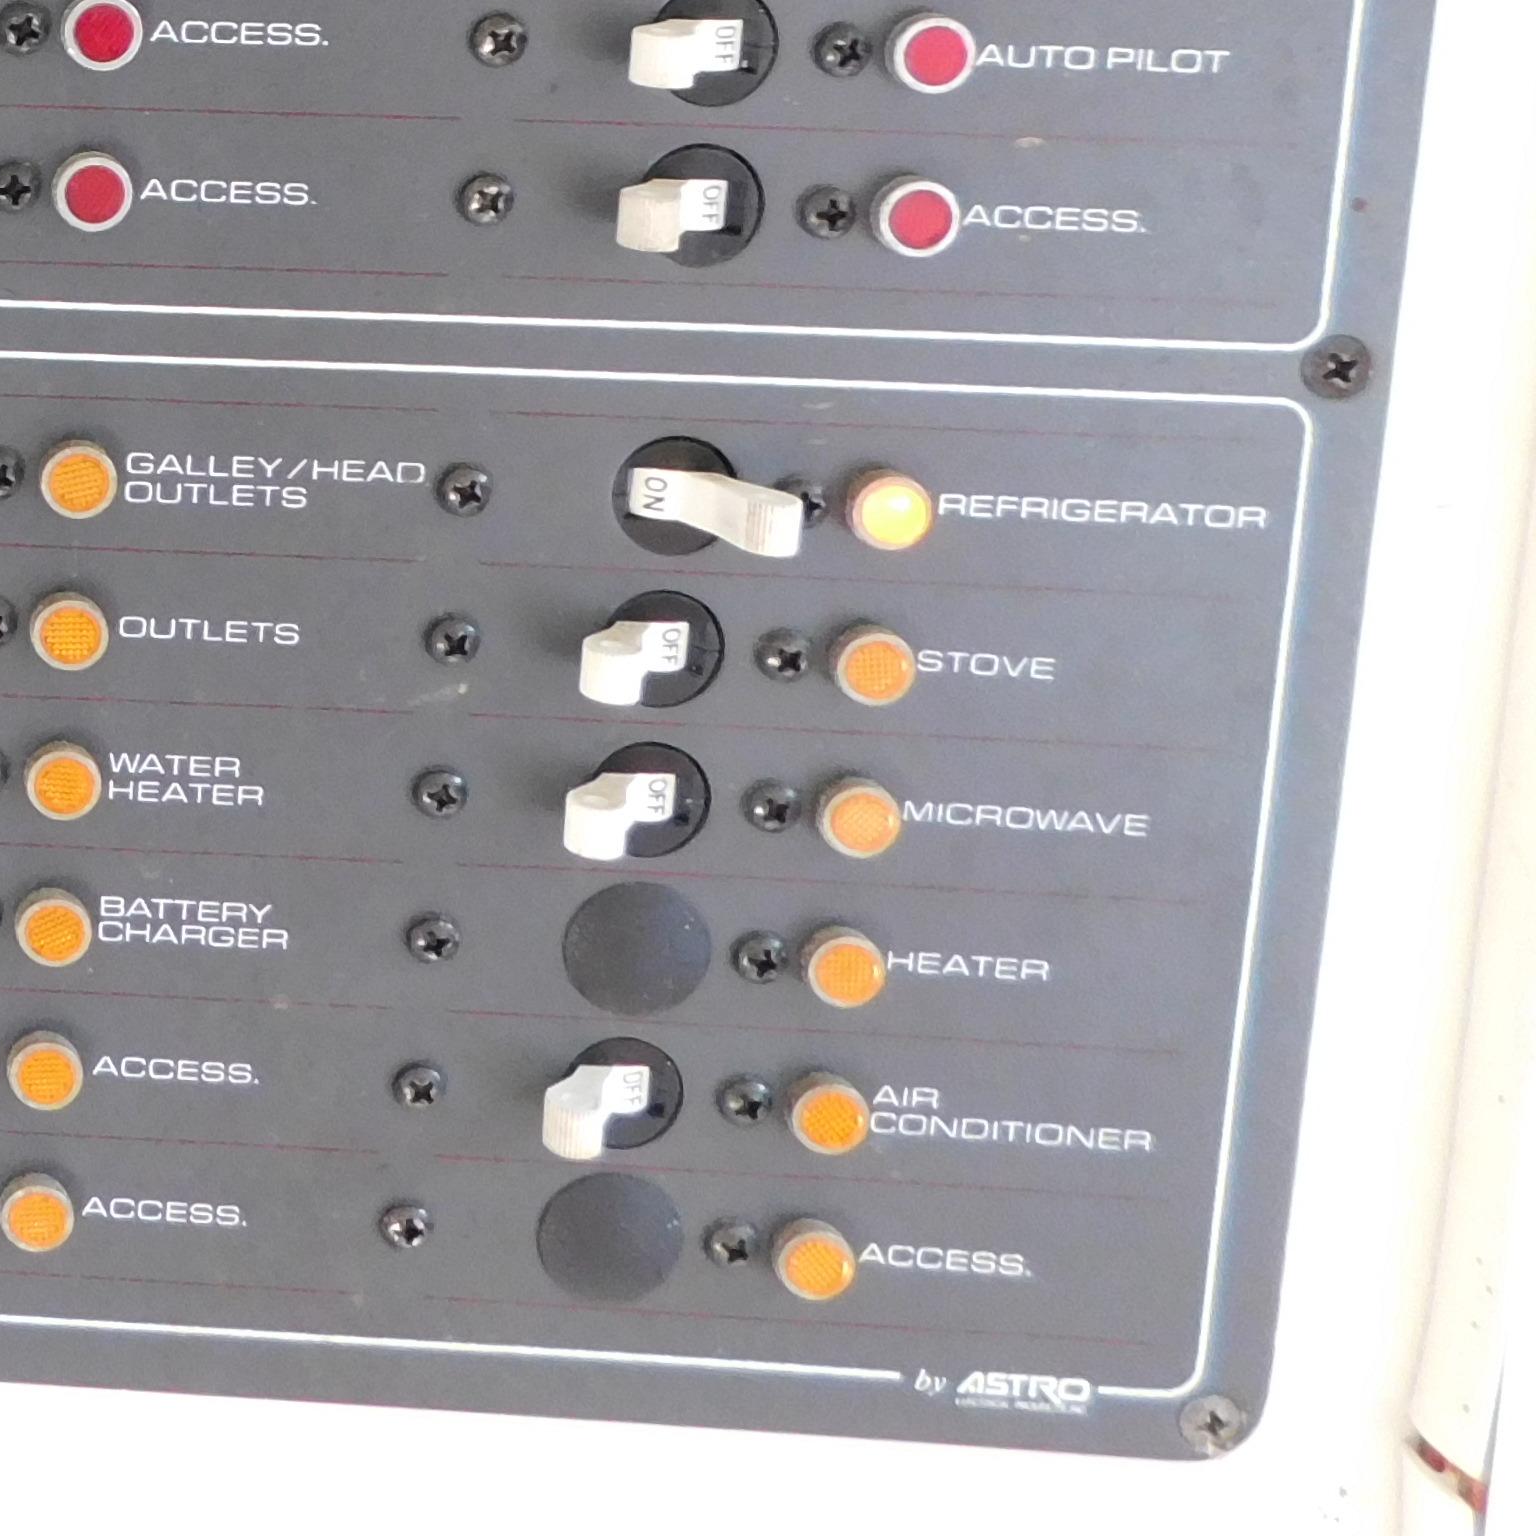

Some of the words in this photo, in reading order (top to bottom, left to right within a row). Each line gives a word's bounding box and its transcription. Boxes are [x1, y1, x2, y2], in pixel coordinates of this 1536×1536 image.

[149, 20, 329, 46] ACCESS.
[715, 25, 738, 63] OFF
[976, 43, 1096, 71] AUTO
[1106, 46, 1231, 74] PILOT
[140, 178, 316, 206] ACCESS.
[702, 184, 723, 224] OFF
[962, 204, 1147, 233] ACCESS.
[126, 451, 426, 484] GALLEY/HEAD
[124, 480, 307, 509] OUTLETS
[642, 476, 668, 512] ON
[937, 493, 1268, 529] REFRIGERATOR
[118, 615, 300, 645] OUTLETS
[661, 627, 682, 665] OFF
[916, 649, 1056, 680] STOVE
[109, 752, 241, 778] WATER
[108, 779, 264, 806] HEATER
[647, 778, 669, 815] OFF
[901, 800, 1149, 837] MICROWAVE
[100, 895, 272, 924] BATTERY
[97, 920, 289, 950] CHARGER
[886, 950, 1050, 981] HEATER
[92, 1055, 259, 1085] ACCESS.
[622, 1070, 645, 1112] OFF
[872, 1084, 940, 1110] AIR
[869, 1111, 1152, 1152] CONDITIONER
[81, 1196, 247, 1227] ACCESS.
[858, 1242, 1032, 1277] ACCESS.
[955, 1369, 1091, 1405] ASTRO
